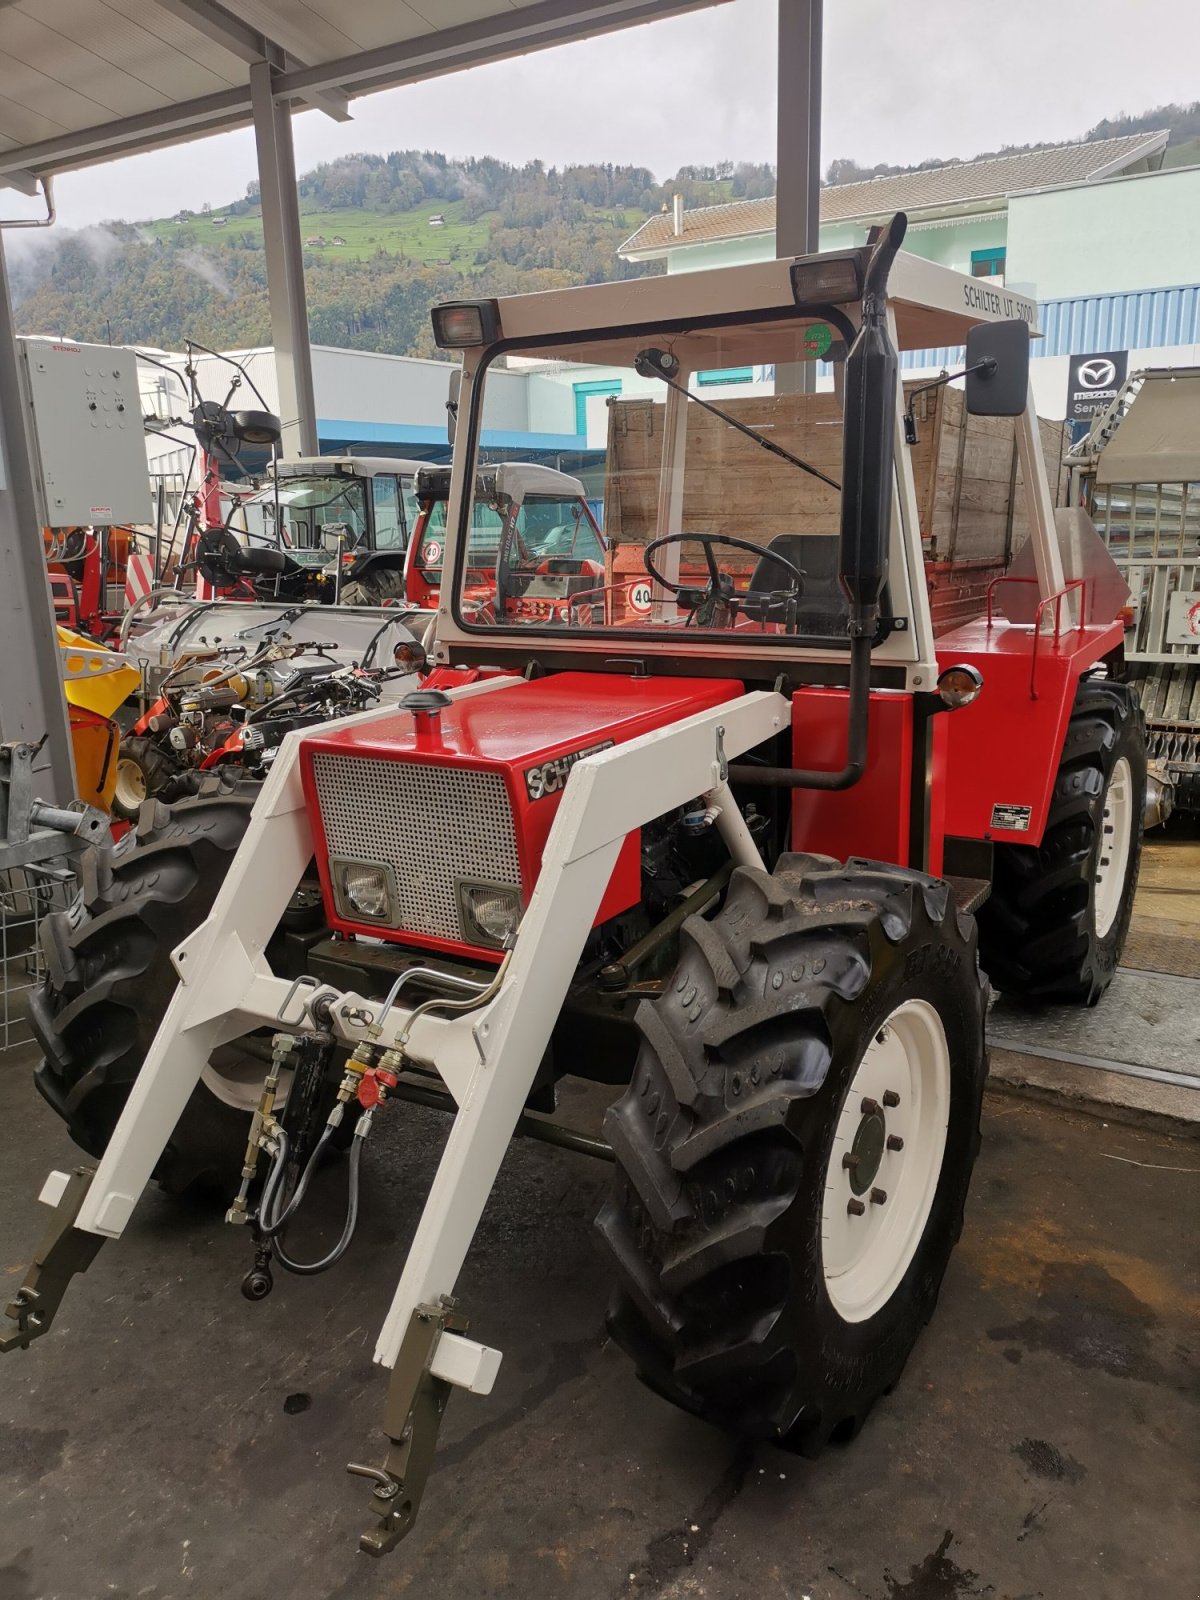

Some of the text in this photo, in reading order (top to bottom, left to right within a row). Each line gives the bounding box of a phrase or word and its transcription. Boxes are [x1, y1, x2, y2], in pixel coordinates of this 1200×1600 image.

[964, 284, 1001, 315] SCHILTER
[1003, 297, 1014, 318] UT
[1073, 401, 1110, 414] Servic
[427, 547, 437, 557] 40
[635, 590, 650, 604] 40
